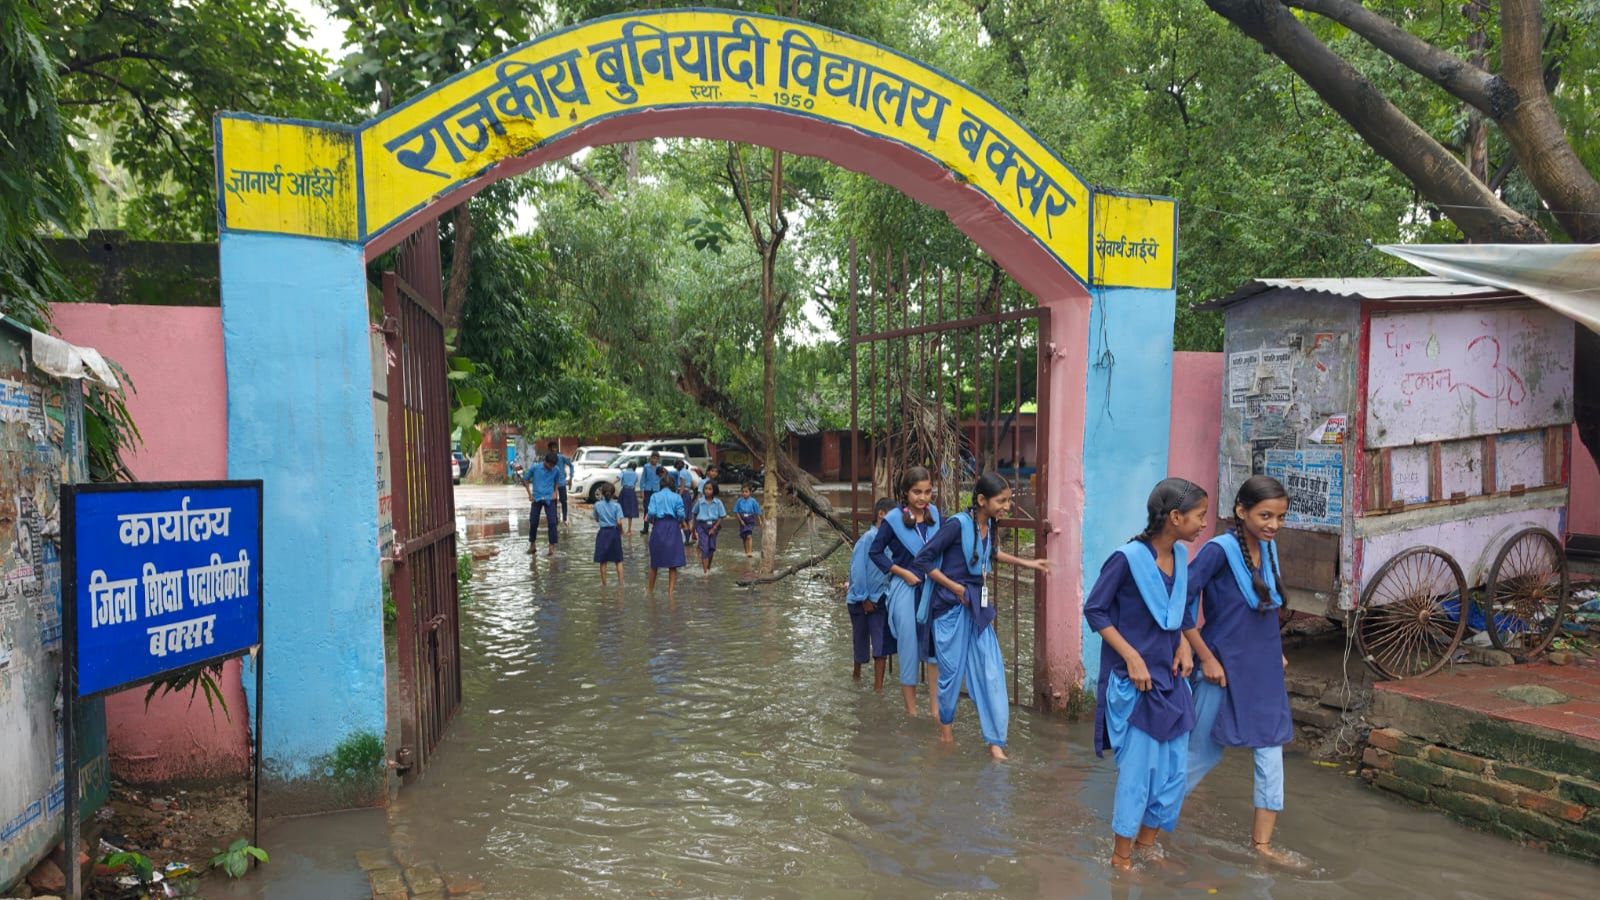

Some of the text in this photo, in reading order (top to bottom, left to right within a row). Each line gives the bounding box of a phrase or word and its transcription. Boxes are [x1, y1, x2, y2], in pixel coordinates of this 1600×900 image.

[773, 92, 815, 110] 1950
[383, 18, 1076, 240] राजकीय बुनियादी विद्यालय बक्सर
[117, 496, 232, 547] कार्यालय
[89, 569, 138, 628] जिला
[142, 561, 183, 618] शिक्षा
[186, 549, 250, 607] पदाधिकारी
[147, 613, 216, 658] बक्सर
